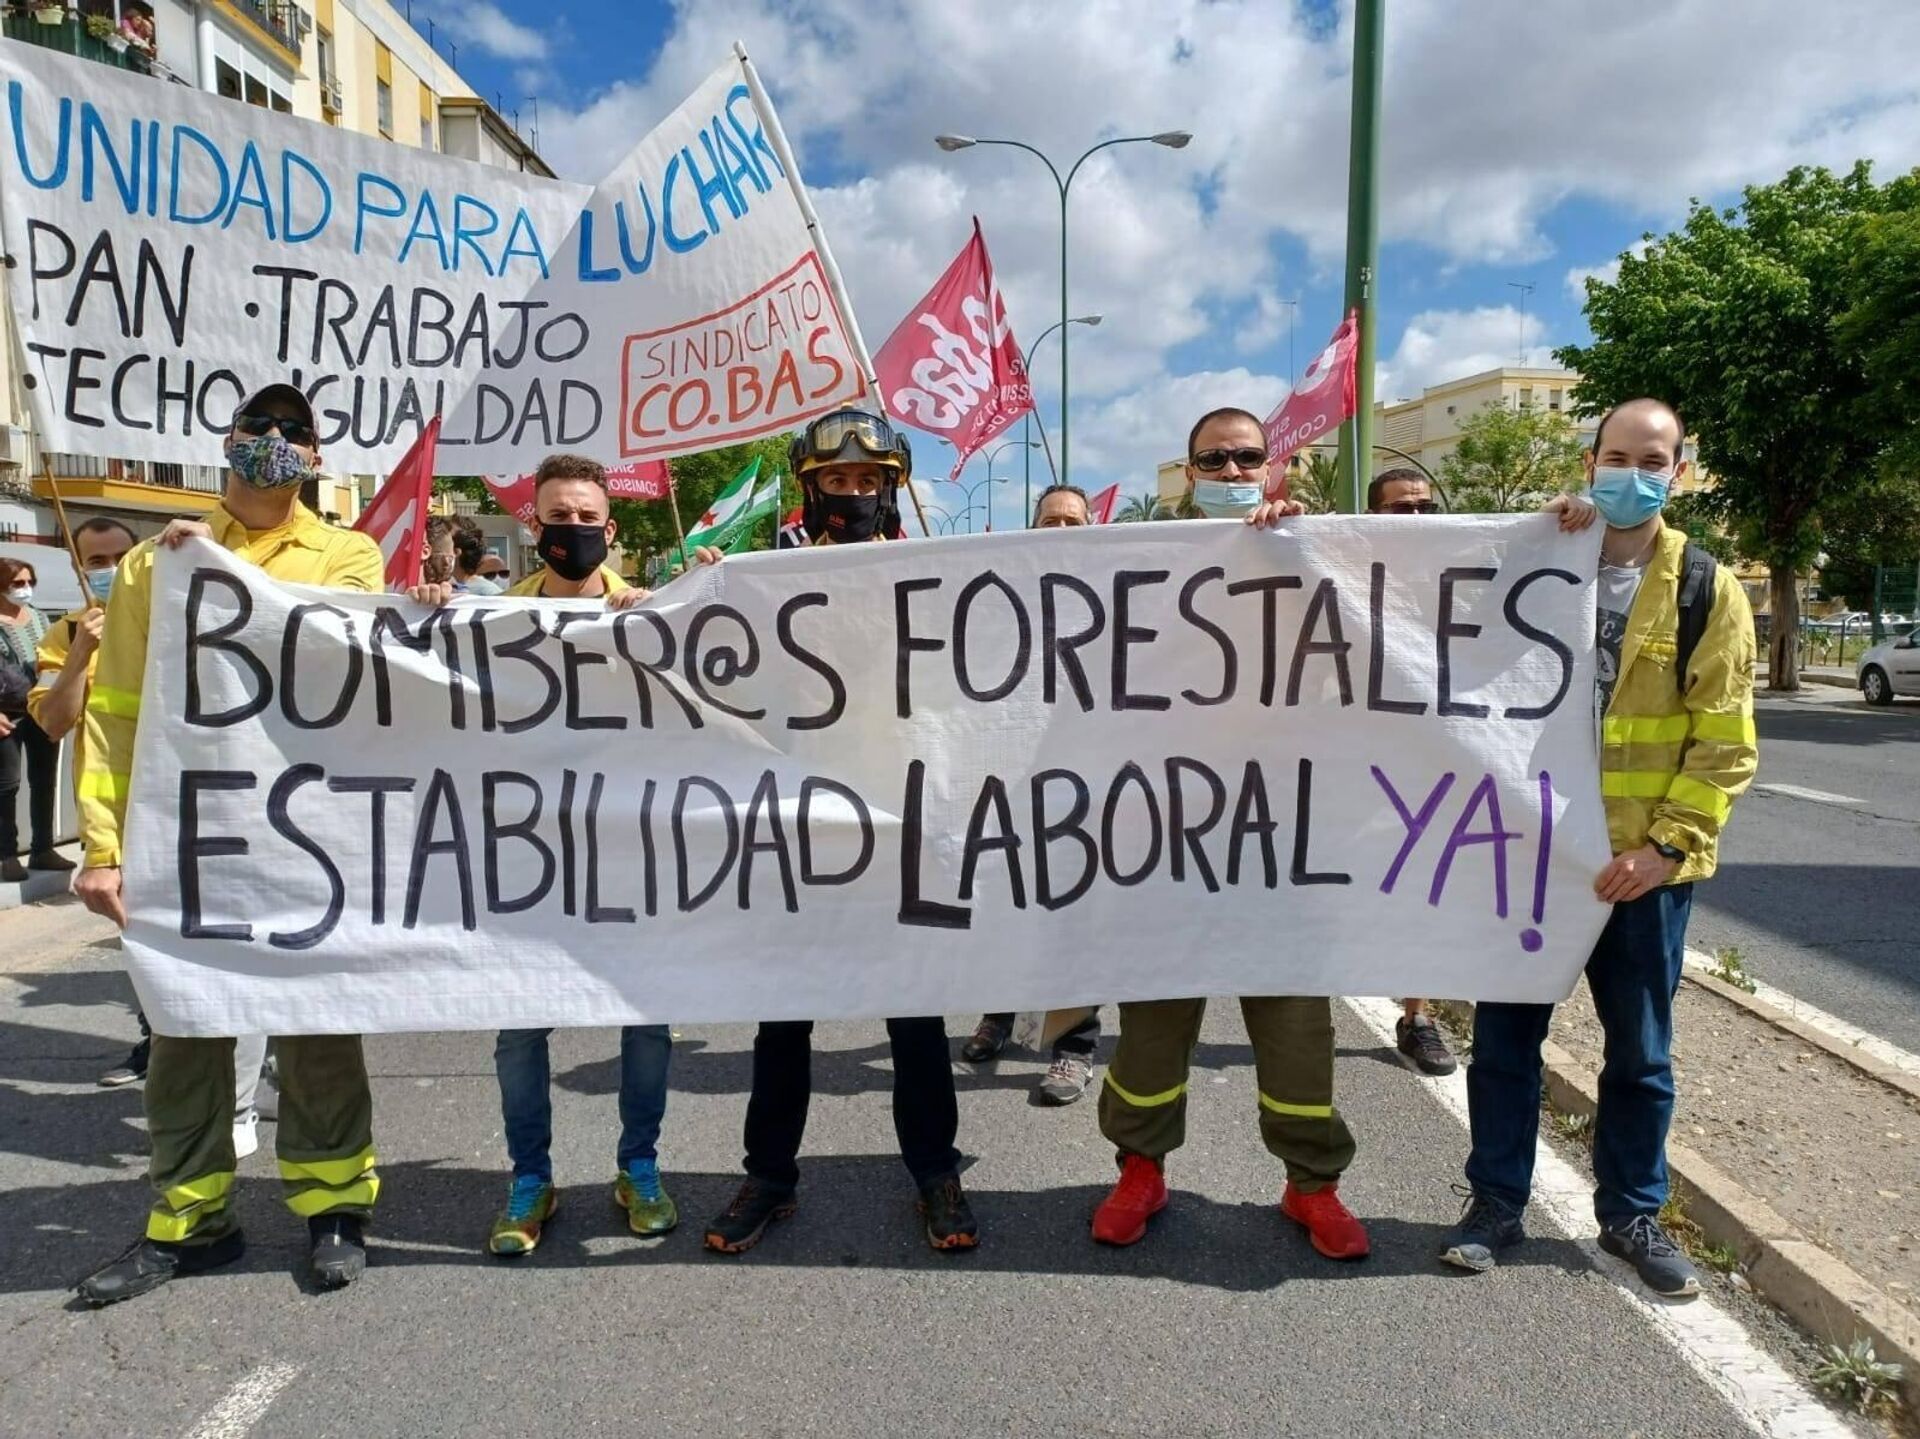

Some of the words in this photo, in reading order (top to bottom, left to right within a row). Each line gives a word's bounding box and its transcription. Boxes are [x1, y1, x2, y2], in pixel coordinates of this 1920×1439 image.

[8, 81, 332, 243] UNIDAD
[354, 172, 549, 280] PARA
[577, 84, 785, 281] LUCHAR
[631, 326, 843, 438] CO.BAS
[641, 280, 821, 379] SINDICATO
[292, 369, 602, 448] GUALDAD
[183, 567, 847, 733] BOMBER@S
[895, 561, 1582, 721] FORESTALES
[177, 763, 876, 951] ESTABILIDAD
[897, 756, 1354, 931] LABORAL
[1370, 765, 1553, 953] YA!
